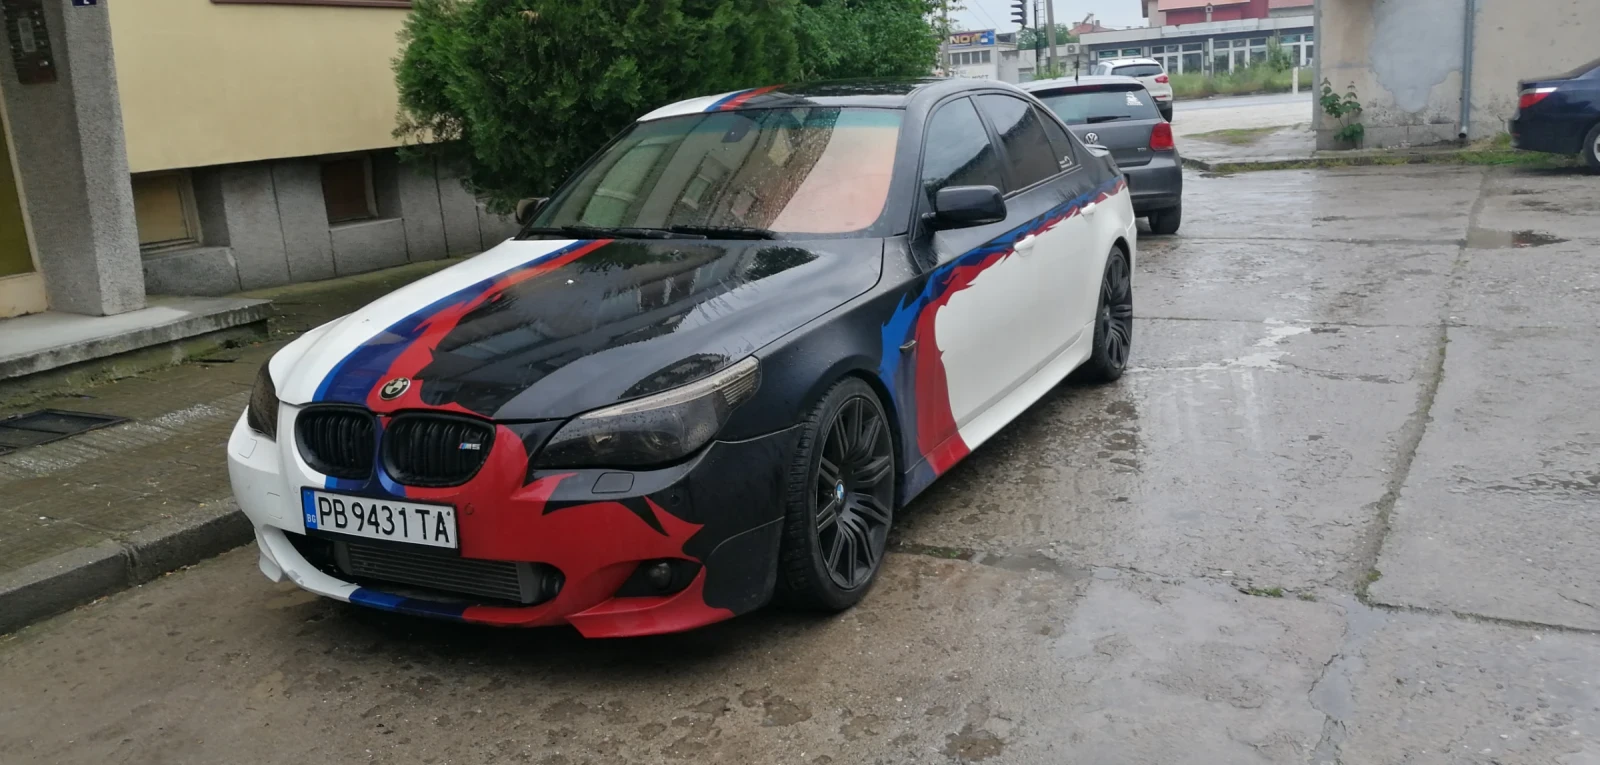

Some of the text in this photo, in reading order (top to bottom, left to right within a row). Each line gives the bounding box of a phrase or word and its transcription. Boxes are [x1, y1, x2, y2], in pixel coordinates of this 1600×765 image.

[307, 513, 317, 523] BG
[318, 496, 450, 543] PB 9431 TA
